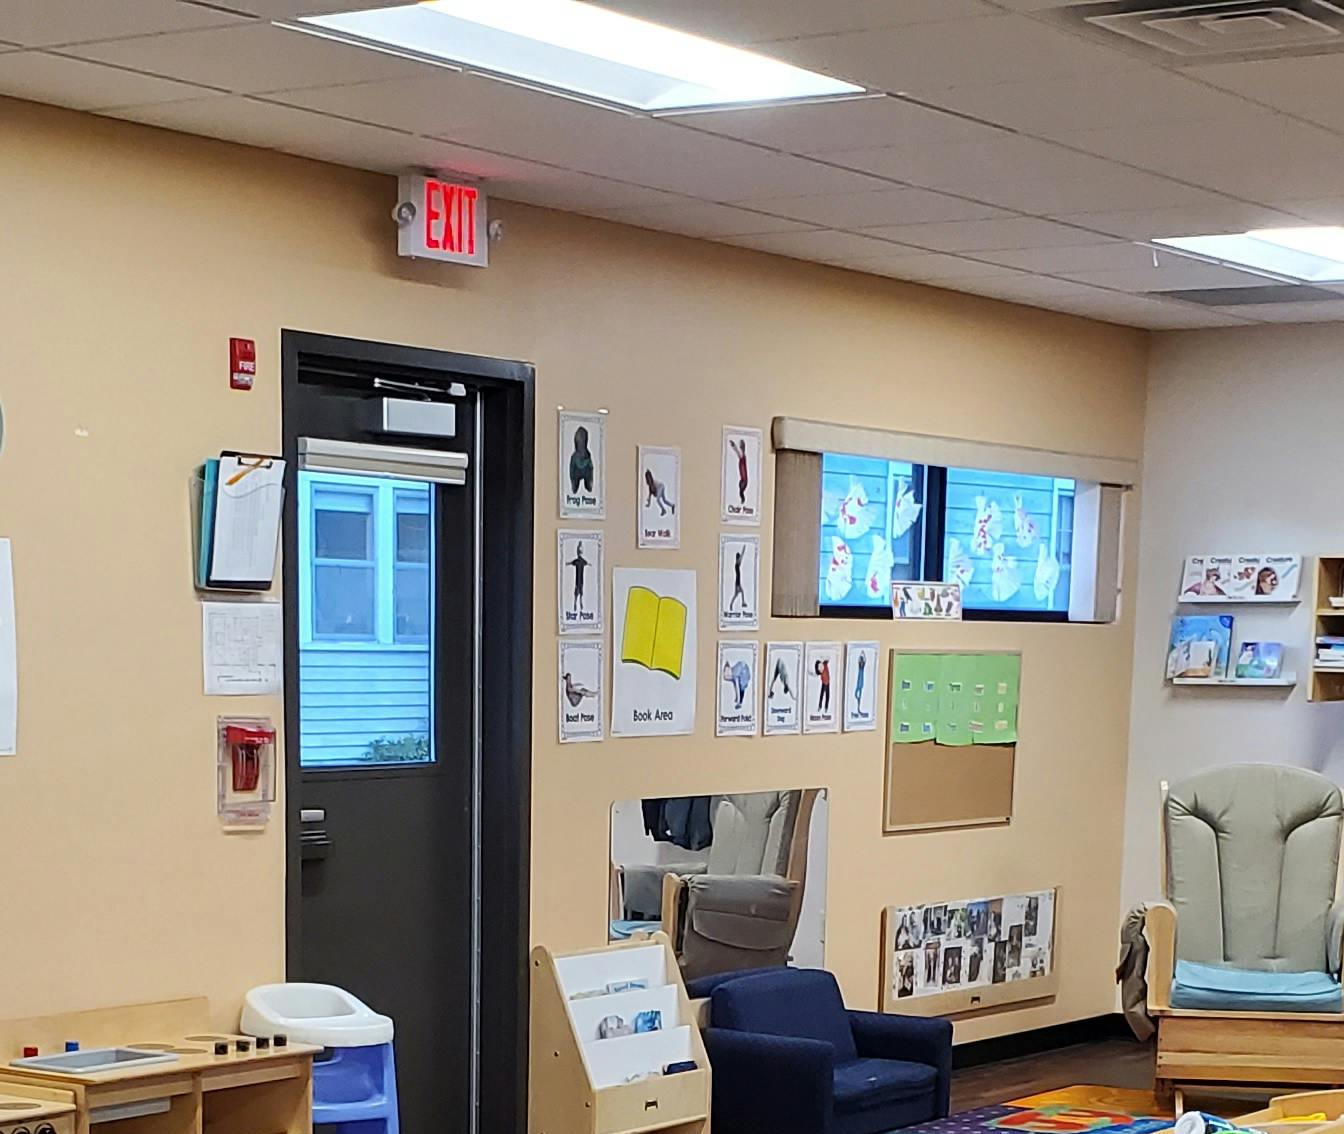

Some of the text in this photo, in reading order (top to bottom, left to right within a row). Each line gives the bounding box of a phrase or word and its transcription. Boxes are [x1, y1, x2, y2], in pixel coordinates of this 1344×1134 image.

[425, 180, 478, 256] EXIT
[633, 708, 673, 721] Book Area
